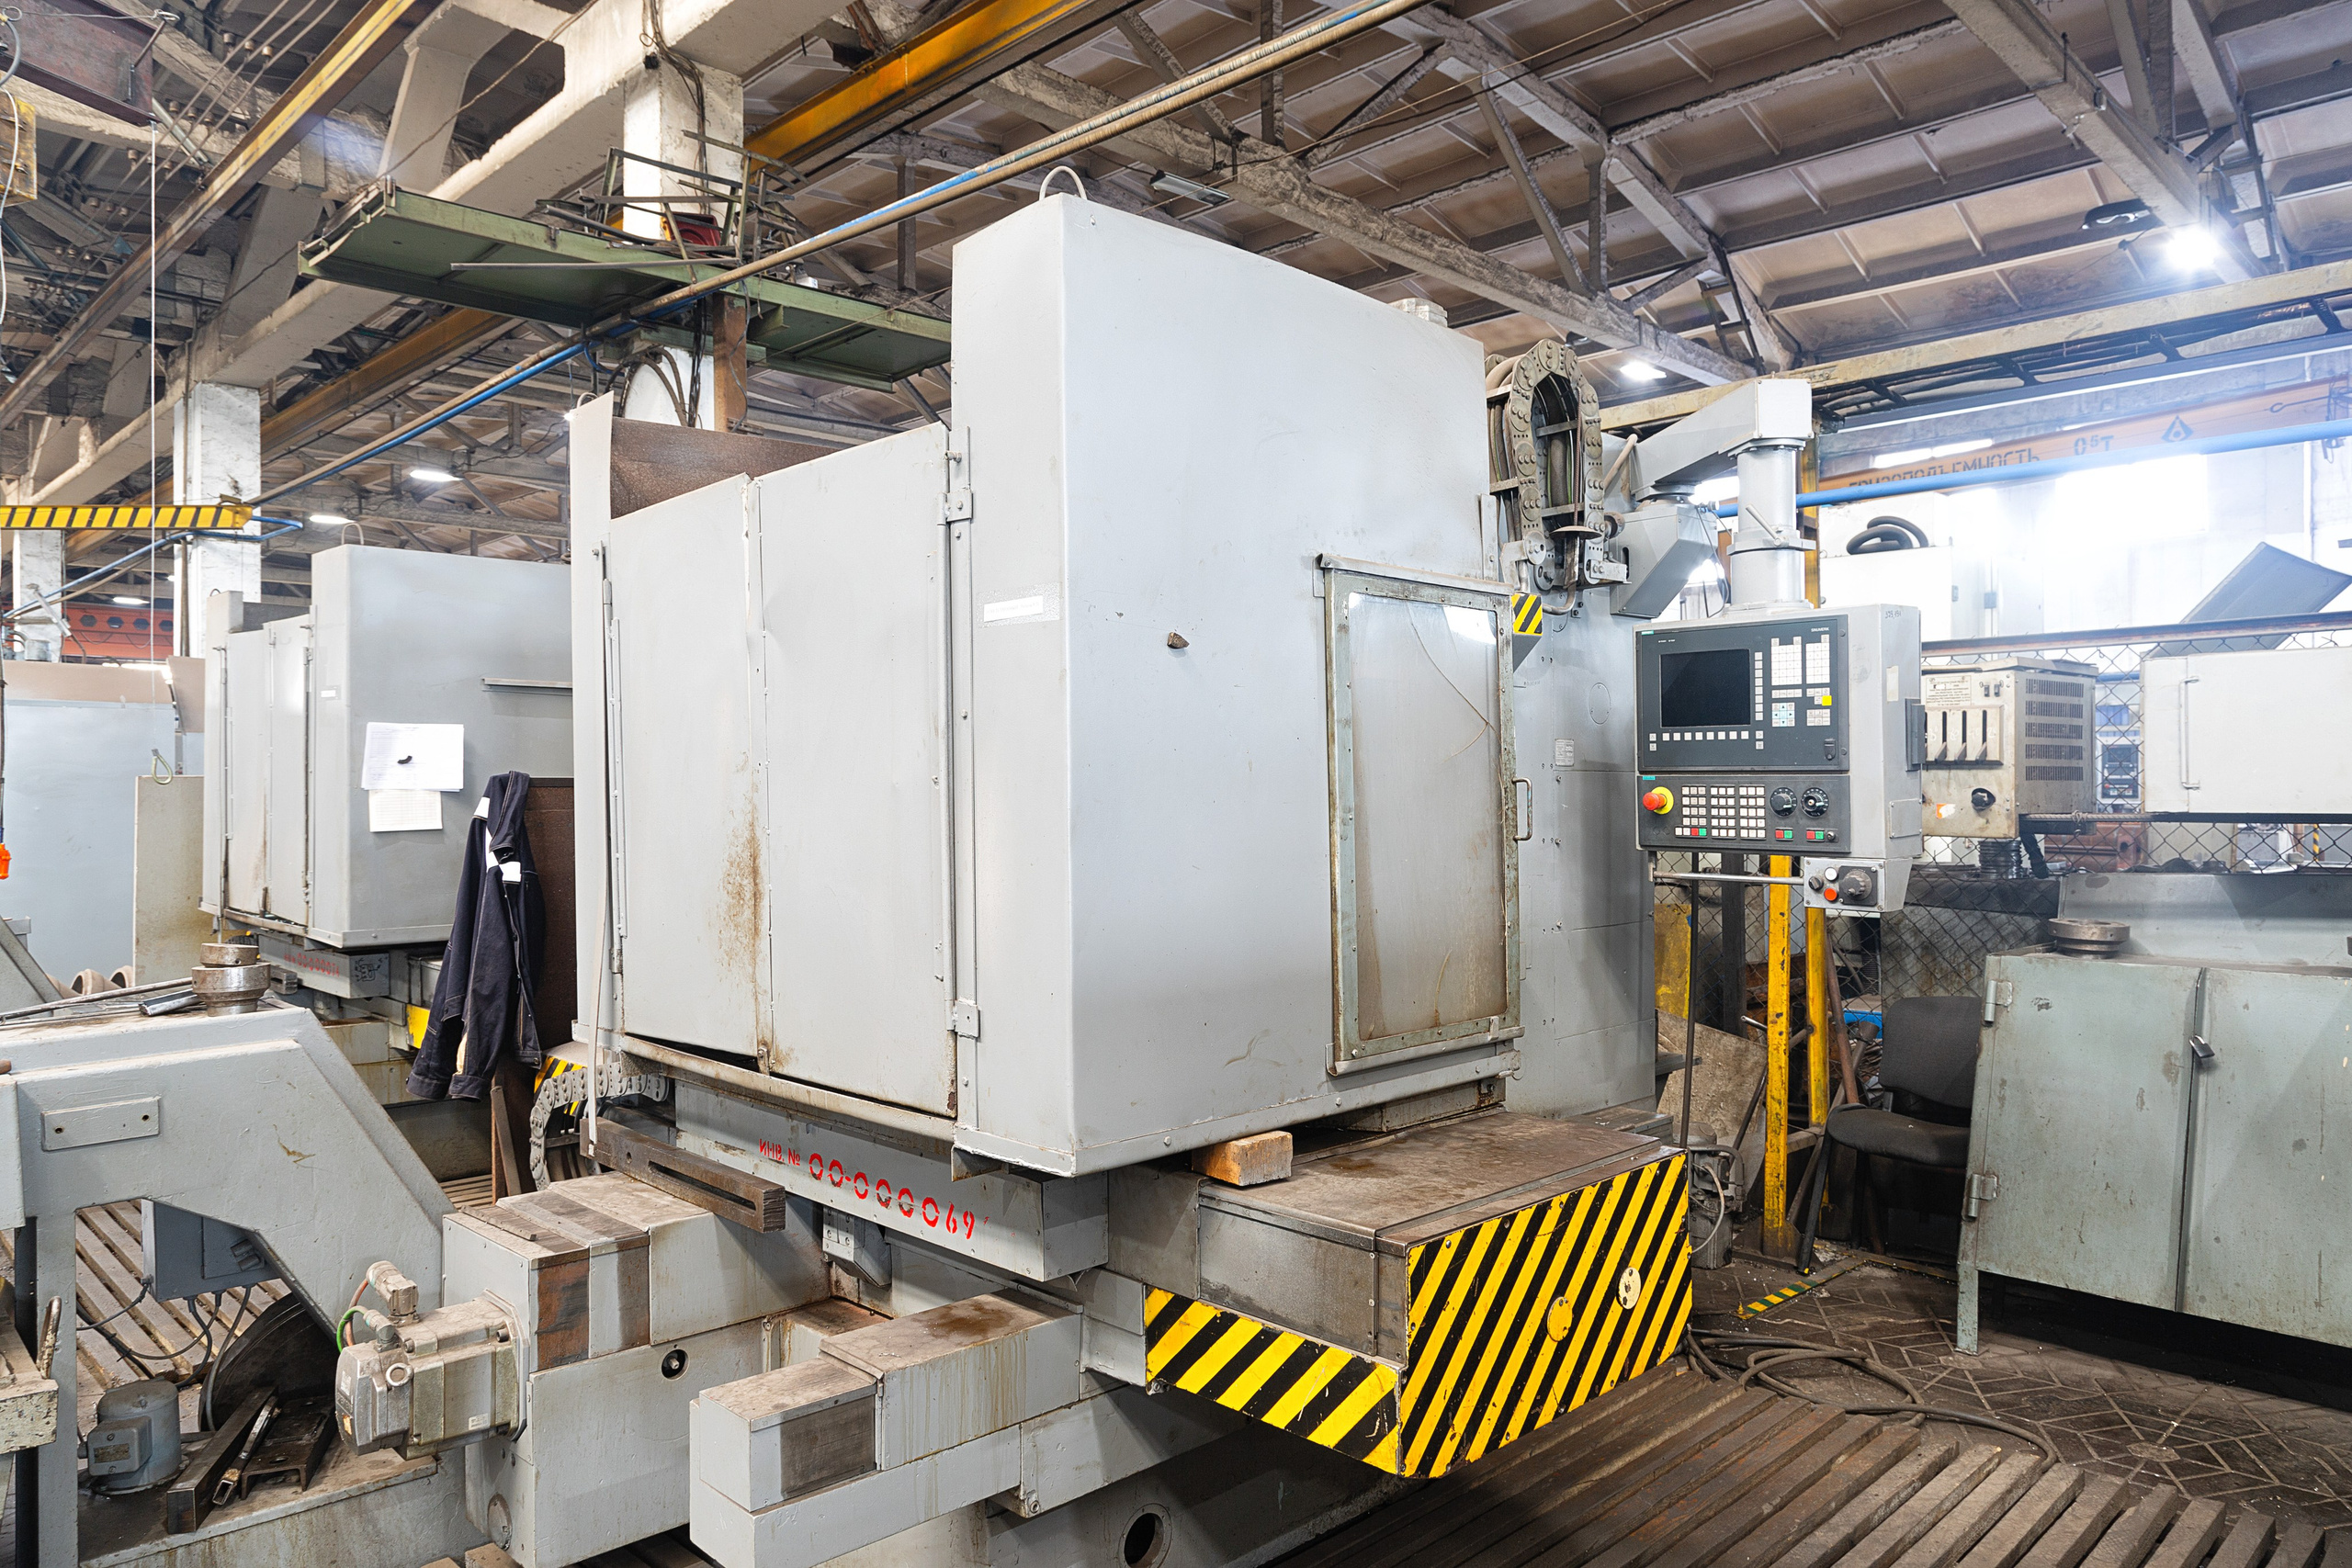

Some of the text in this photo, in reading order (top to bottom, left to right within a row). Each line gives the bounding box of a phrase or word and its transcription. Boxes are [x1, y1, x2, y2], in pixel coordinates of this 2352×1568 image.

[1848, 447, 2041, 487] ДЪЕМНОСТЬ
[787, 1147, 801, 1167] №
[808, 1152, 976, 1240] 00-000069
